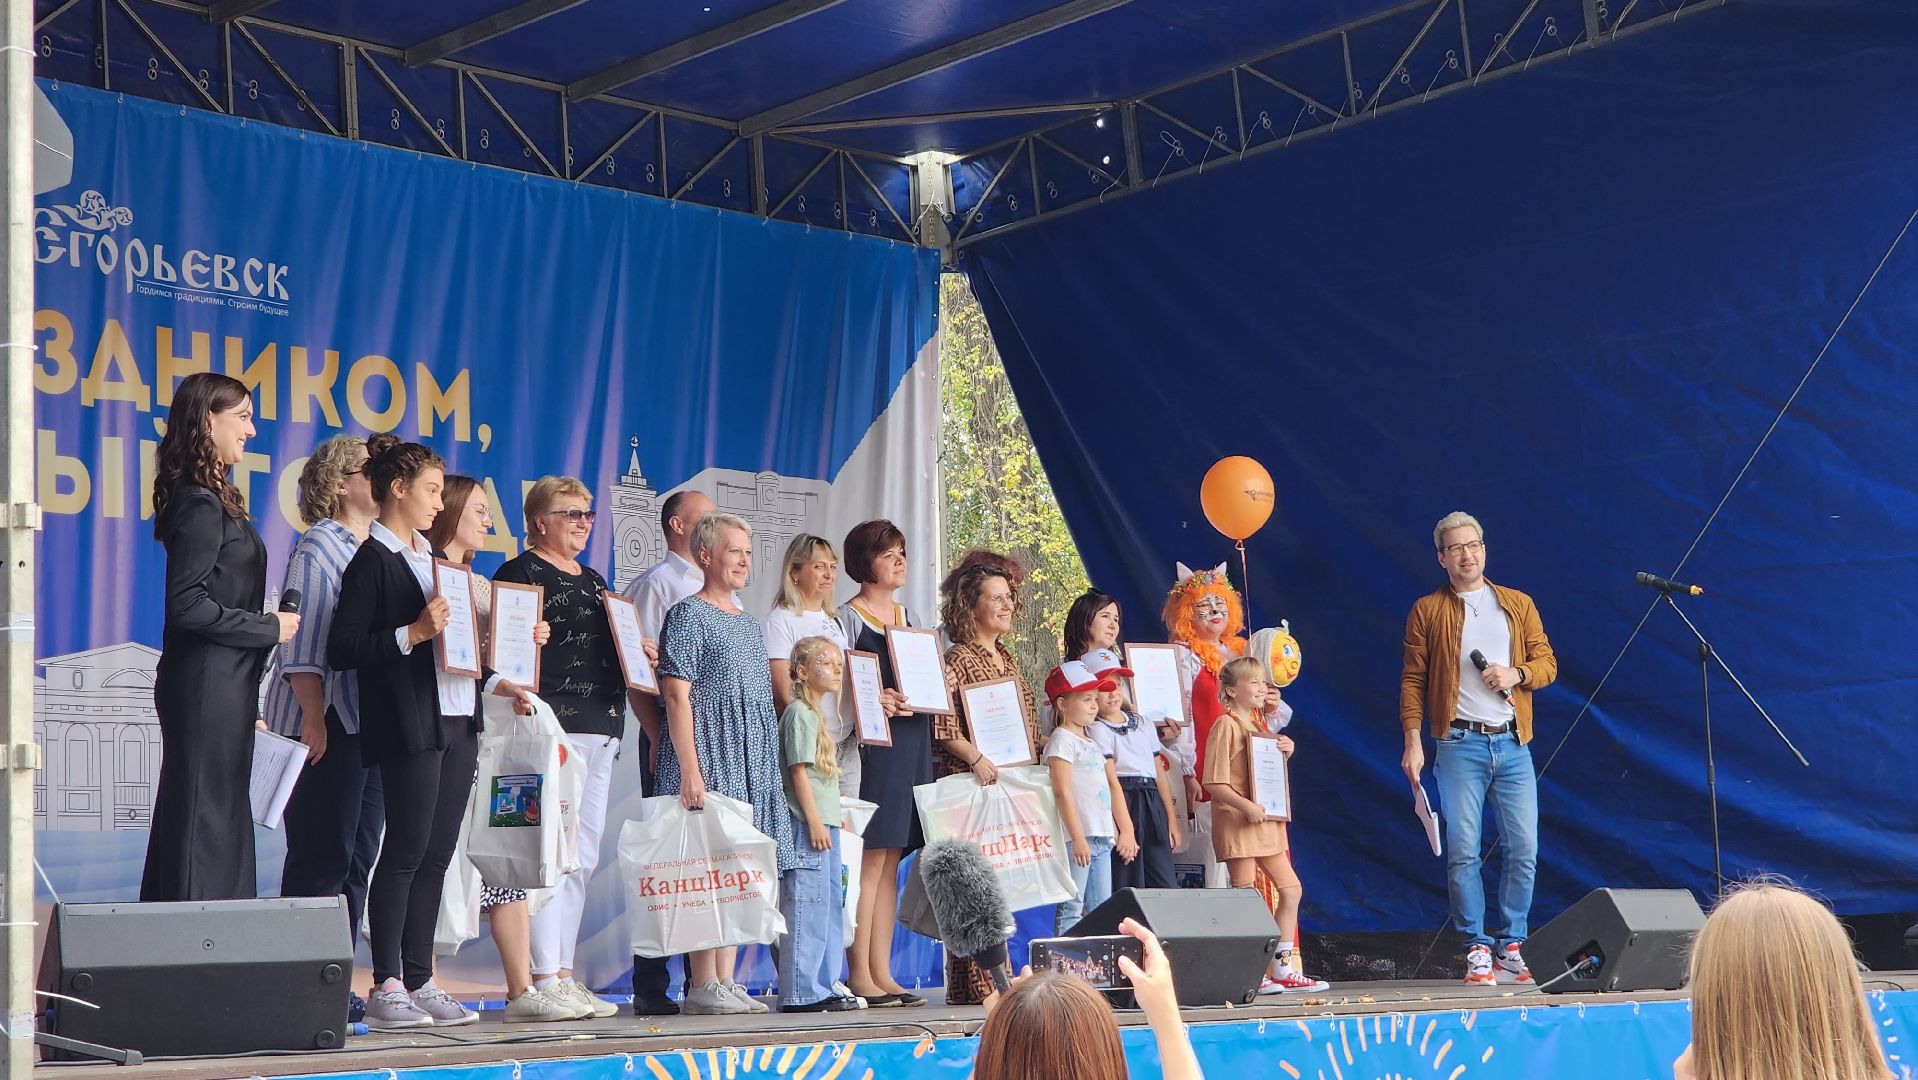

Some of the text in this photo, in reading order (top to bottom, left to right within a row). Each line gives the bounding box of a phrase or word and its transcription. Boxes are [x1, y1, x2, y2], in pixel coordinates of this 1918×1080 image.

[136, 283, 172, 298] Гордимся
[227, 298, 258, 310] Строим
[258, 303, 289, 317] будущее
[647, 903, 670, 912] ОФИС
